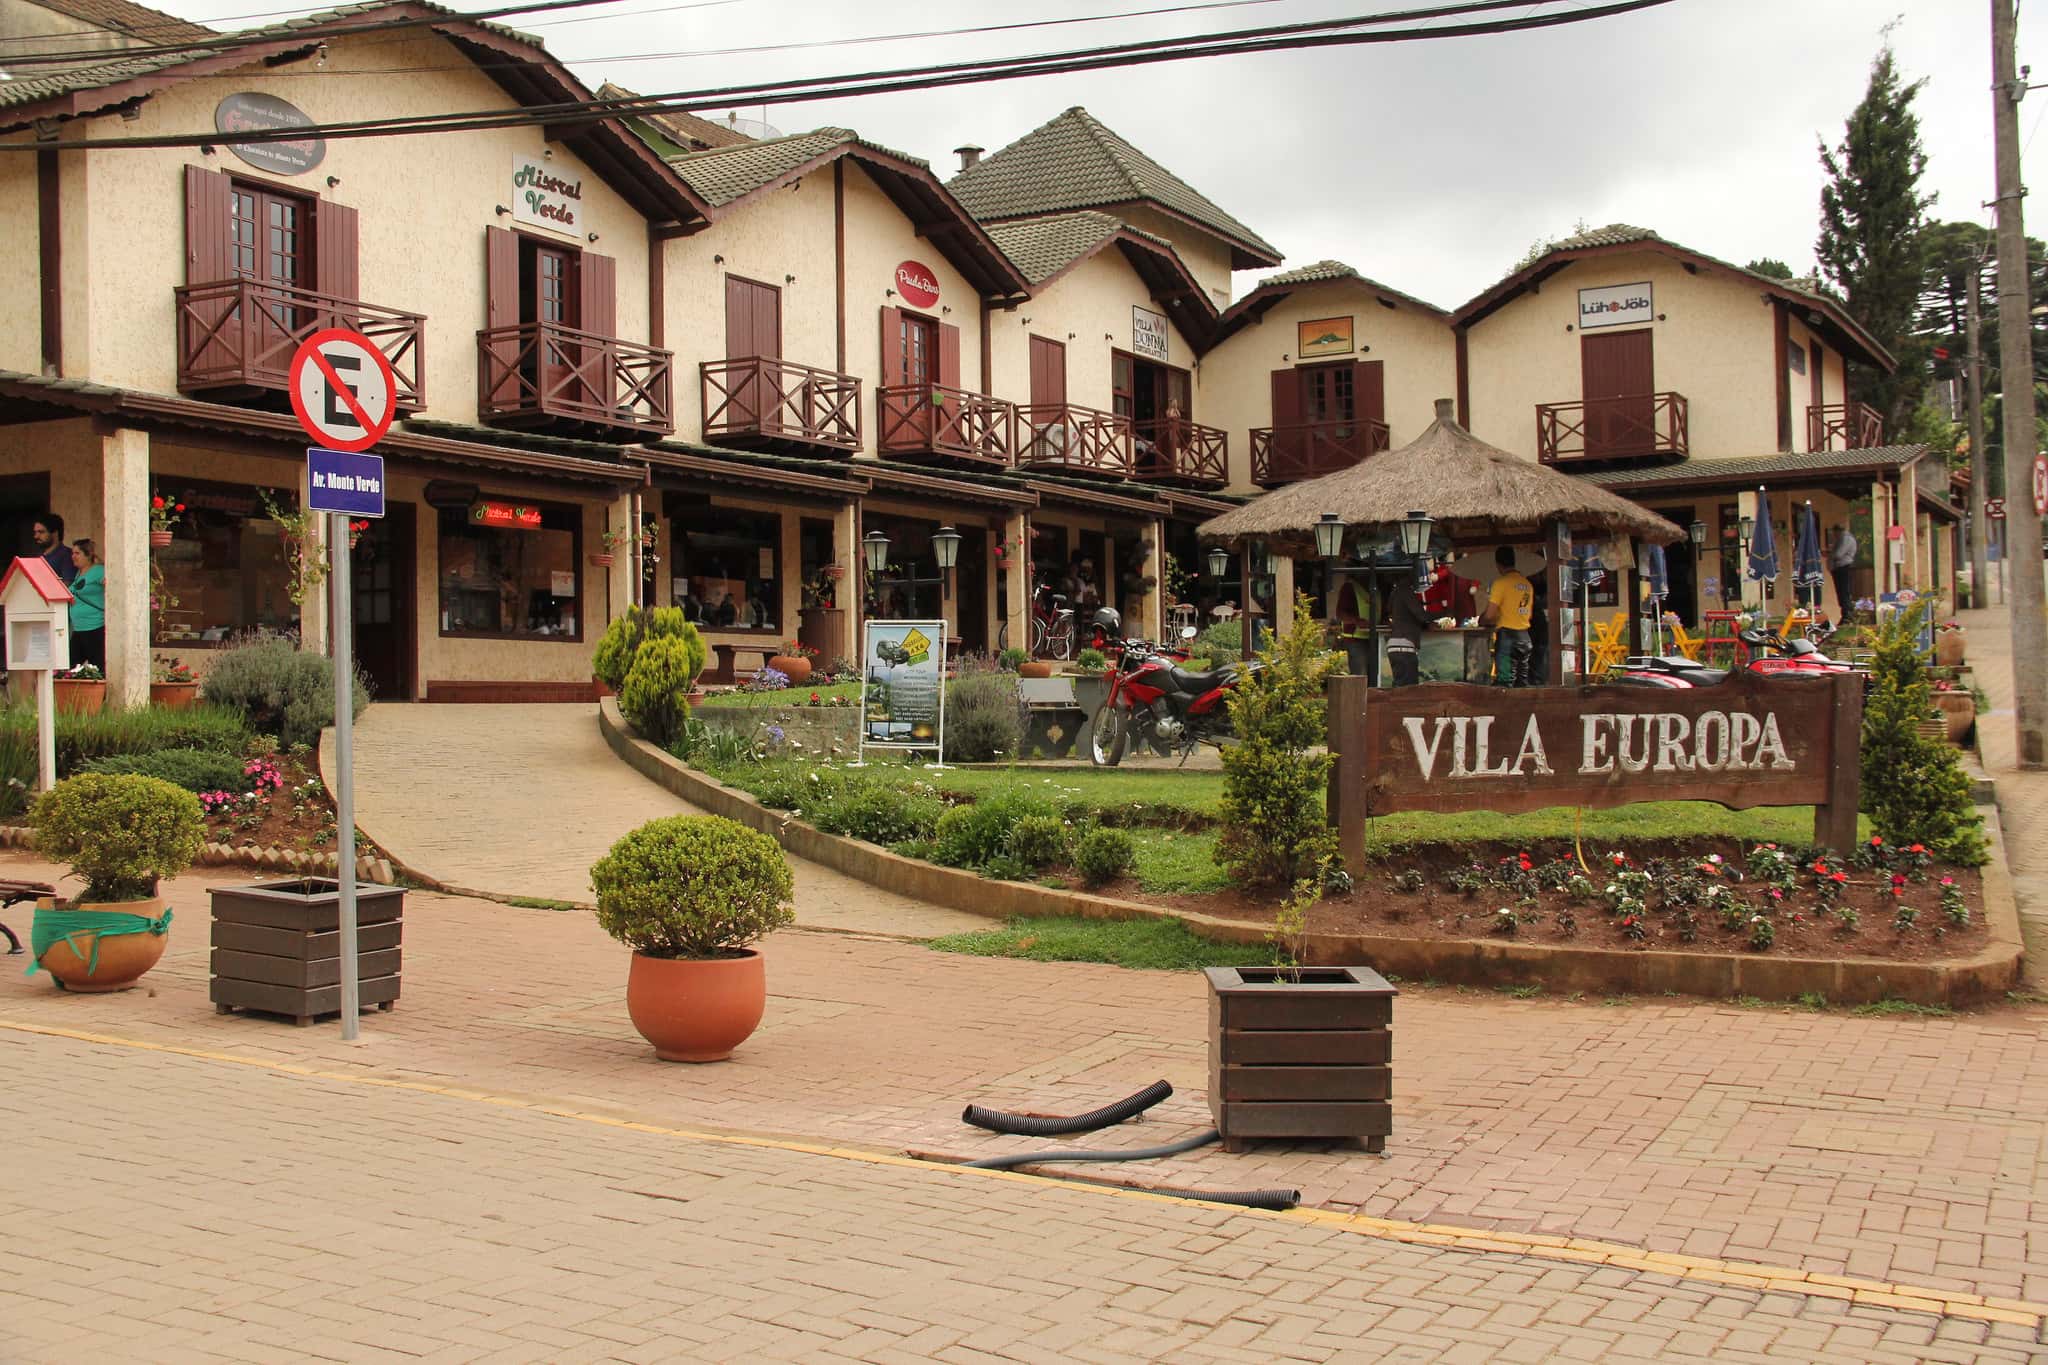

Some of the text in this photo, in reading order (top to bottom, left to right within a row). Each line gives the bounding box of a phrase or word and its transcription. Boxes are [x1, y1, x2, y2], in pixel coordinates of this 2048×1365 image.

[514, 164, 581, 200] Mistral
[525, 190, 574, 225] Verde
[1135, 317, 1152, 332] VILLA
[1135, 328, 1167, 352] DONNA
[312, 470, 380, 493] Av. Monte Verde
[515, 507, 541, 524] Verde
[1402, 710, 1796, 783] VILA EUROPA
